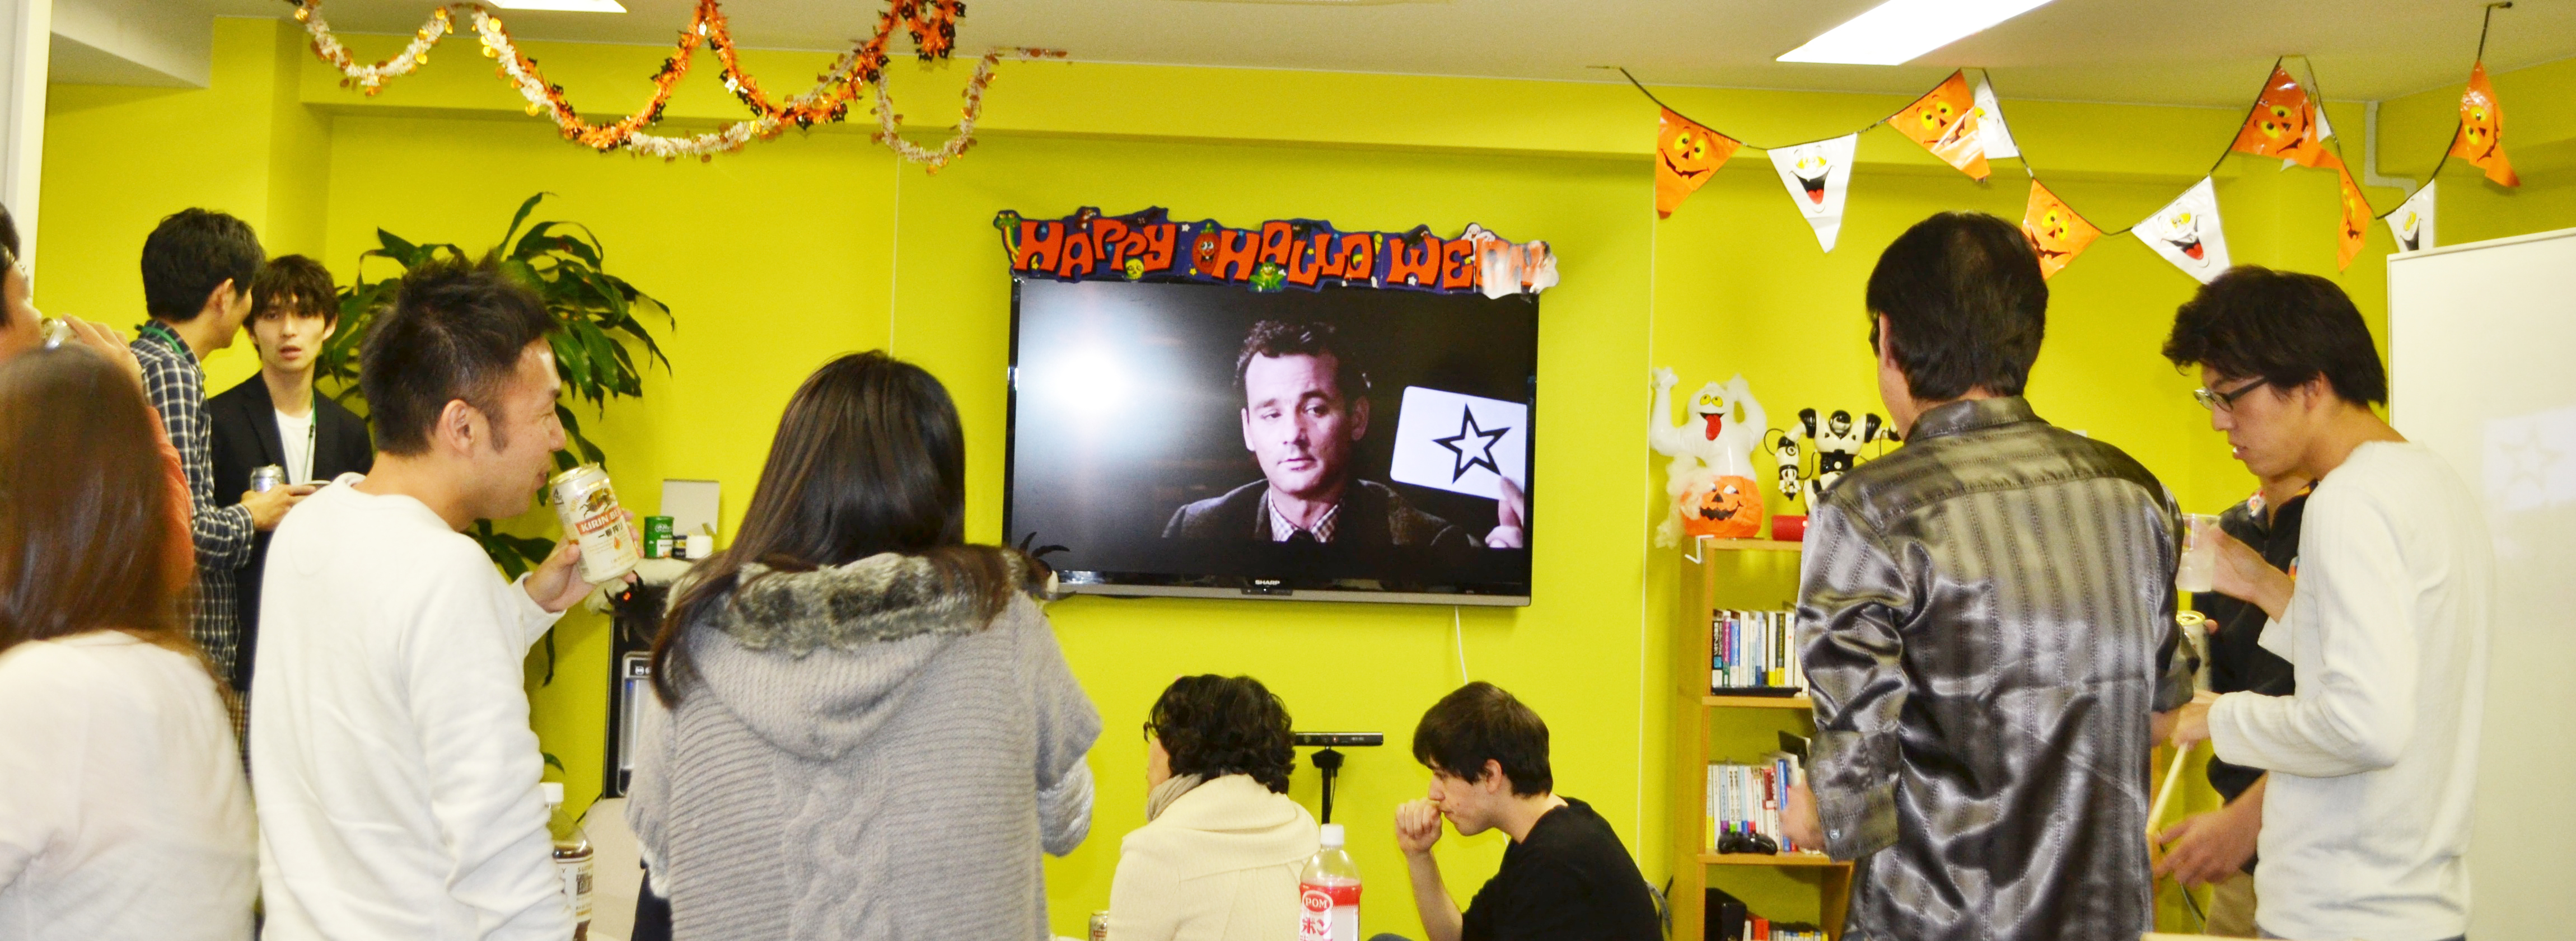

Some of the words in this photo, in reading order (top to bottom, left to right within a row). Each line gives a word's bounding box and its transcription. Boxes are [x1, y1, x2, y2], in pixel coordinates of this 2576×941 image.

[1014, 219, 1176, 277] HAPPY
[581, 514, 609, 532] KIRIN
[1306, 897, 1327, 909] POM
